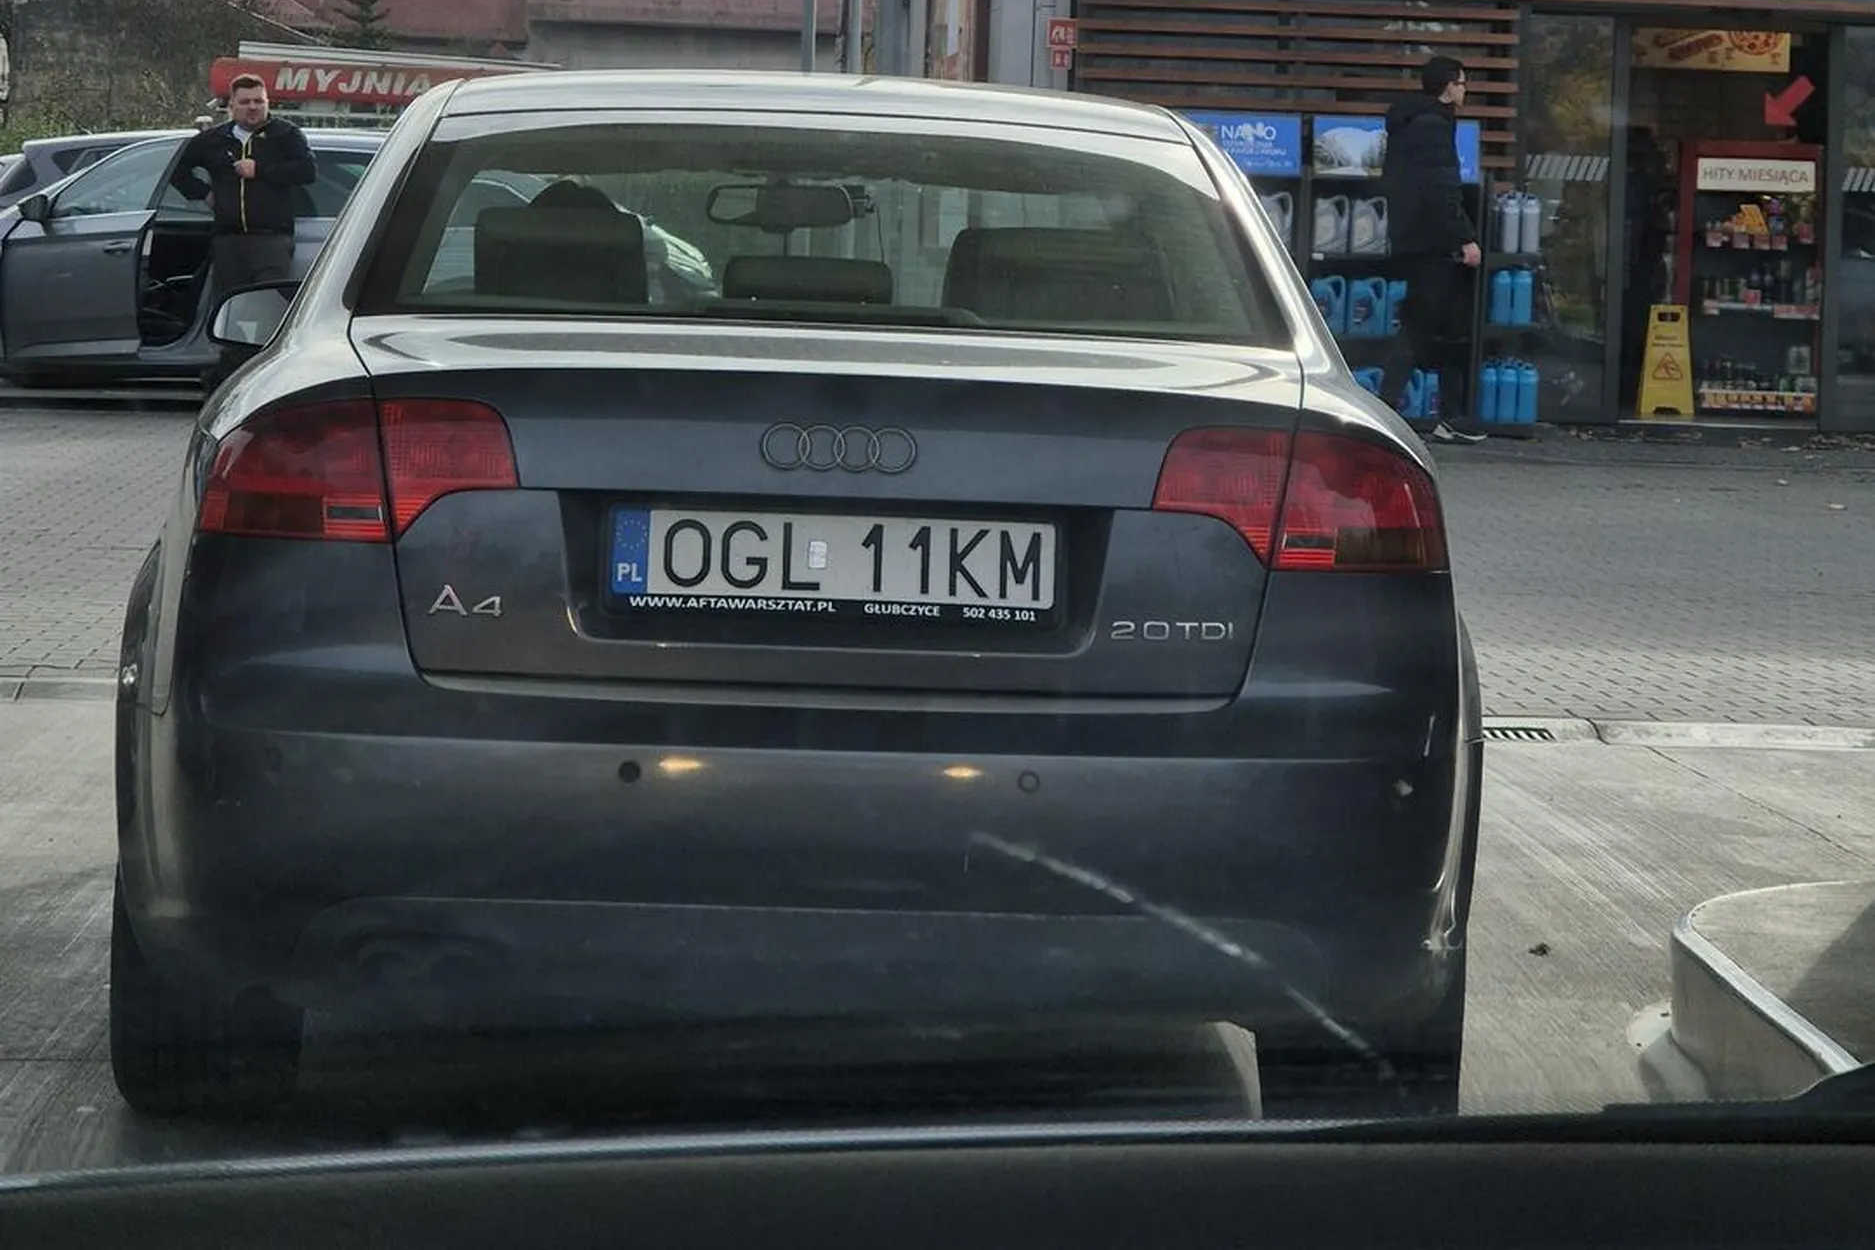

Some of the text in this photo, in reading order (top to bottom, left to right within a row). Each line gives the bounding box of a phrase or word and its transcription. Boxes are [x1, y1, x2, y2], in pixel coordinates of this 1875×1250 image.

[276, 67, 431, 96] MYJNIA
[1738, 168, 1810, 186] MIESIĄCA
[616, 562, 642, 582] PL
[663, 518, 1042, 602] OGL 11KM
[428, 584, 502, 617] A4
[629, 596, 1036, 622] WWW.AFTAWARSZTAT.PL GŁUBCZYCE 502 435 101
